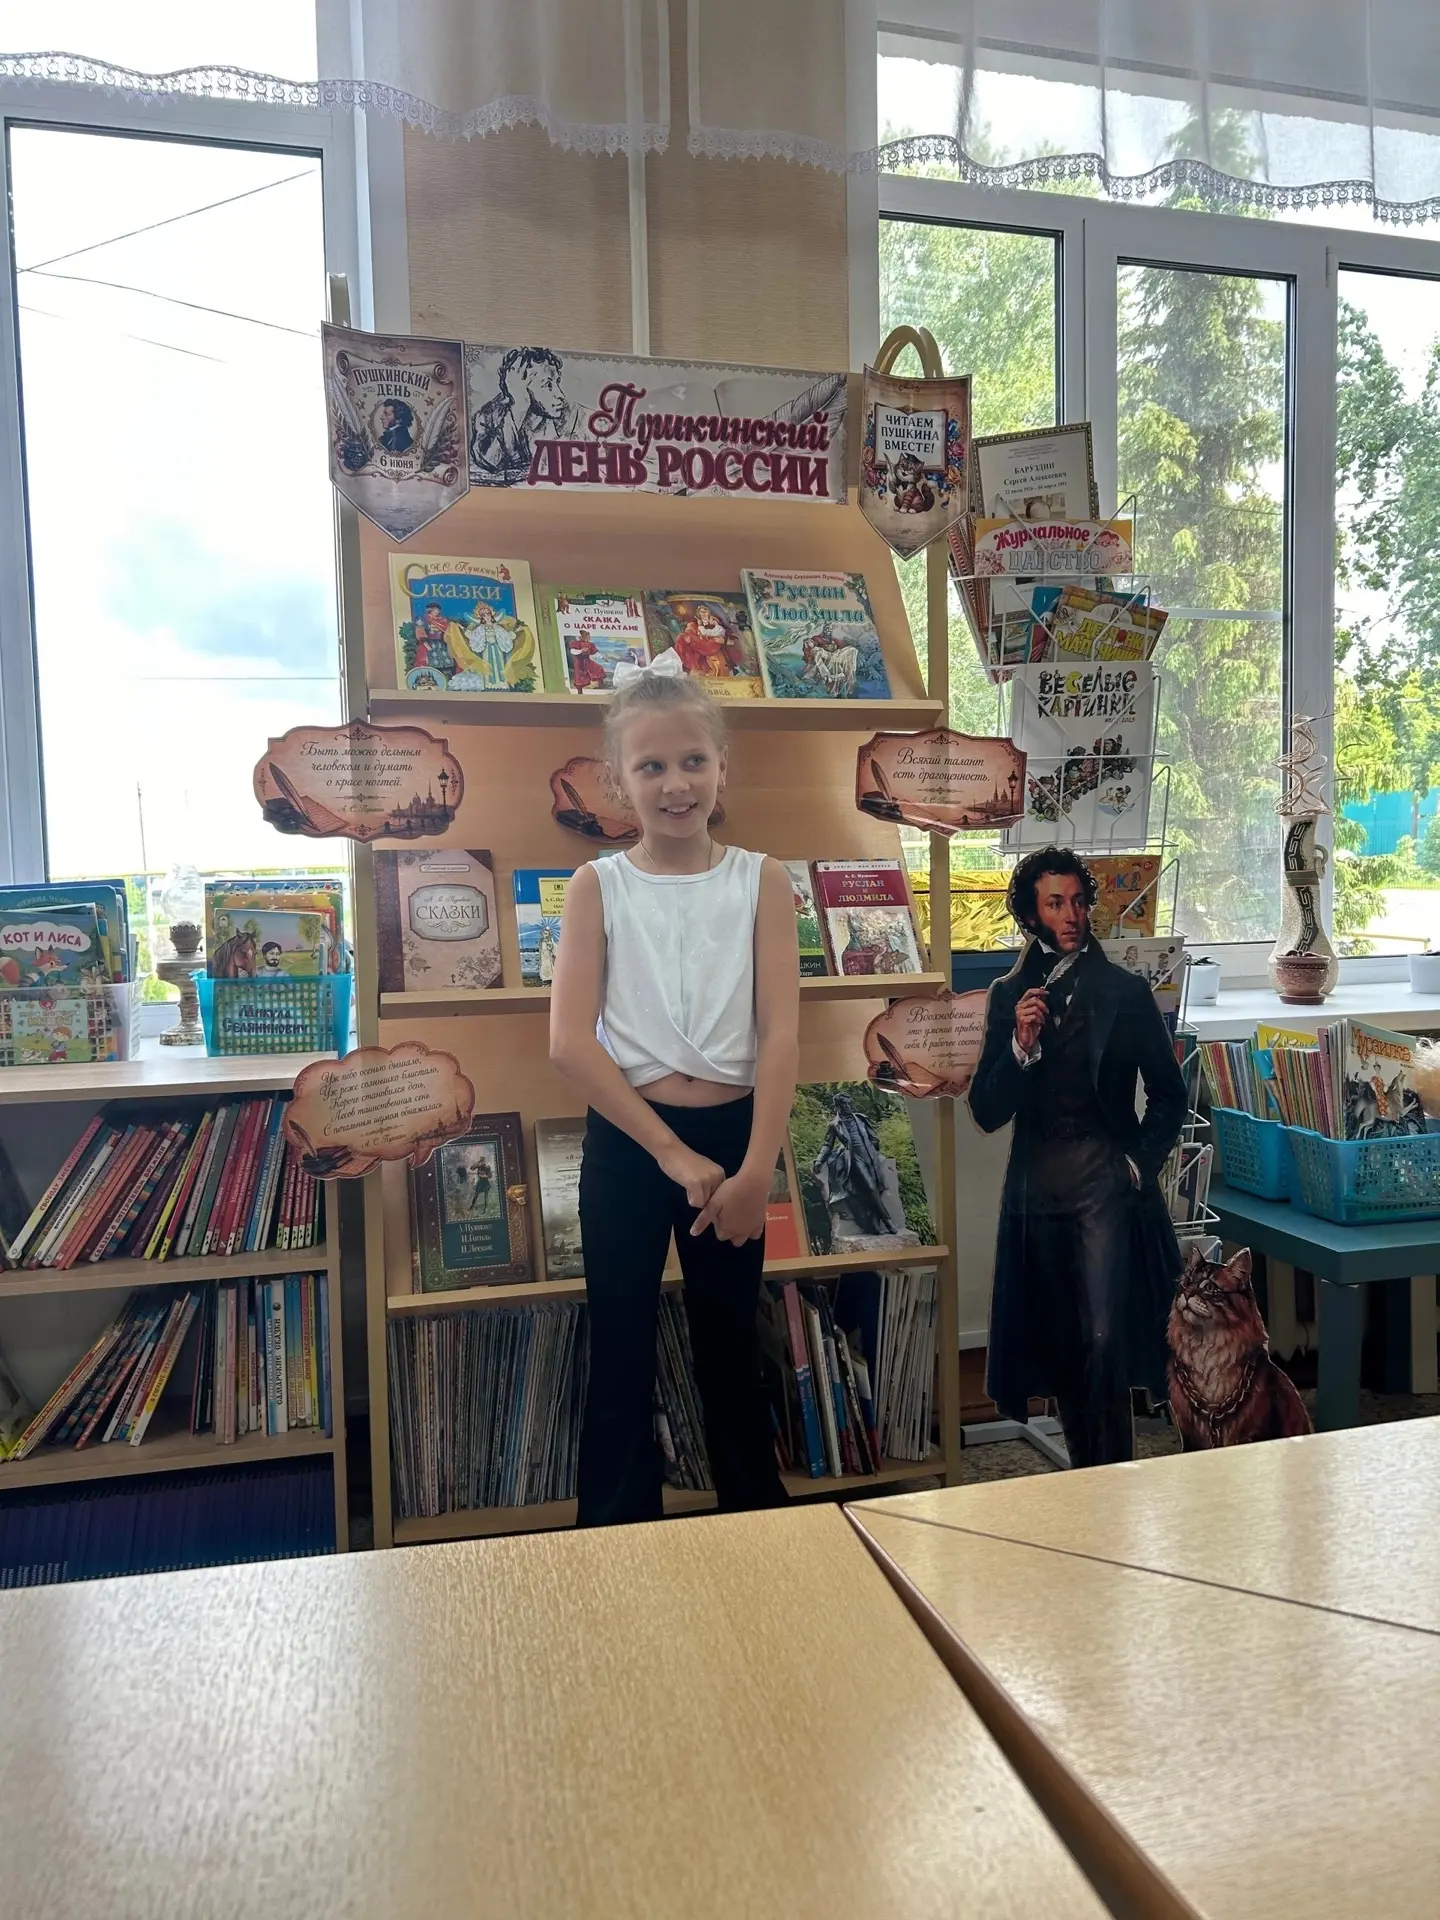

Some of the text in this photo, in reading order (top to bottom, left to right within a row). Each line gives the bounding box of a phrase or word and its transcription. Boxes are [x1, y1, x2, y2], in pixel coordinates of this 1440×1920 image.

[353, 368, 431, 391] ПУШКИНСКИЙ
[377, 384, 411, 397] ДЕНЬ
[588, 383, 830, 459] Пушкинский
[886, 414, 933, 428] ЧИТАЕМ
[881, 427, 939, 440] ПУШКИНА
[885, 440, 934, 453] ВМЕСТЕ!
[380, 456, 413, 469] 6 июня
[527, 440, 830, 497] ДЕНЬ РОССИИ
[993, 525, 1090, 551] Журнальное
[455, 561, 496, 577] Пушкин
[1009, 551, 1103, 573] ЦАРСТВО
[398, 562, 502, 600] Сказки
[773, 580, 847, 602] Руслан
[583, 616, 621, 624] СКАЗКА
[765, 601, 866, 623] Людмила
[1037, 694, 1136, 719] КАРТИНКИ
[300, 741, 421, 757] Быть можно дельным
[896, 747, 984, 768] Всякий талант
[311, 760, 413, 776] человеком и думать
[892, 768, 991, 784] есть драгоценность.
[326, 776, 402, 791] о красе ногтей.
[841, 880, 885, 888] РУСЛАН
[838, 894, 895, 903] ЛЮДМИЛА
[416, 904, 481, 920] СКАЗКИ
[3, 931, 82, 946] КОТ И ЛИСА
[239, 1004, 291, 1022] Микула
[907, 1006, 976, 1023] Вдохновение
[222, 1017, 309, 1035] Селянинович
[906, 1028, 923, 1036] это
[904, 1039, 920, 1050] себя
[922, 1038, 927, 1048] в
[928, 1037, 955, 1052] рабочее
[1351, 1027, 1411, 1062] Мурзилка
[321, 1058, 422, 1085] Уж небо осенью дышало,
[319, 1067, 440, 1101] Уж реже солнышко блистало,
[329, 1096, 360, 1111] Короче
[361, 1086, 406, 1102] становился
[331, 1108, 356, 1123] Лесов
[358, 1096, 413, 1116] таинственная
[324, 1123, 332, 1137] С
[333, 1119, 372, 1135] печальным
[373, 1111, 400, 1127] шумом
[92, 1229, 113, 1257] СКАЗКА
[113, 1178, 145, 1223] ПОТЕРЯННОМ
[142, 1144, 166, 1177] ВРЕМЕНИ
[272, 1318, 283, 1404] САМАРСКИЕ СКАЗКИ
